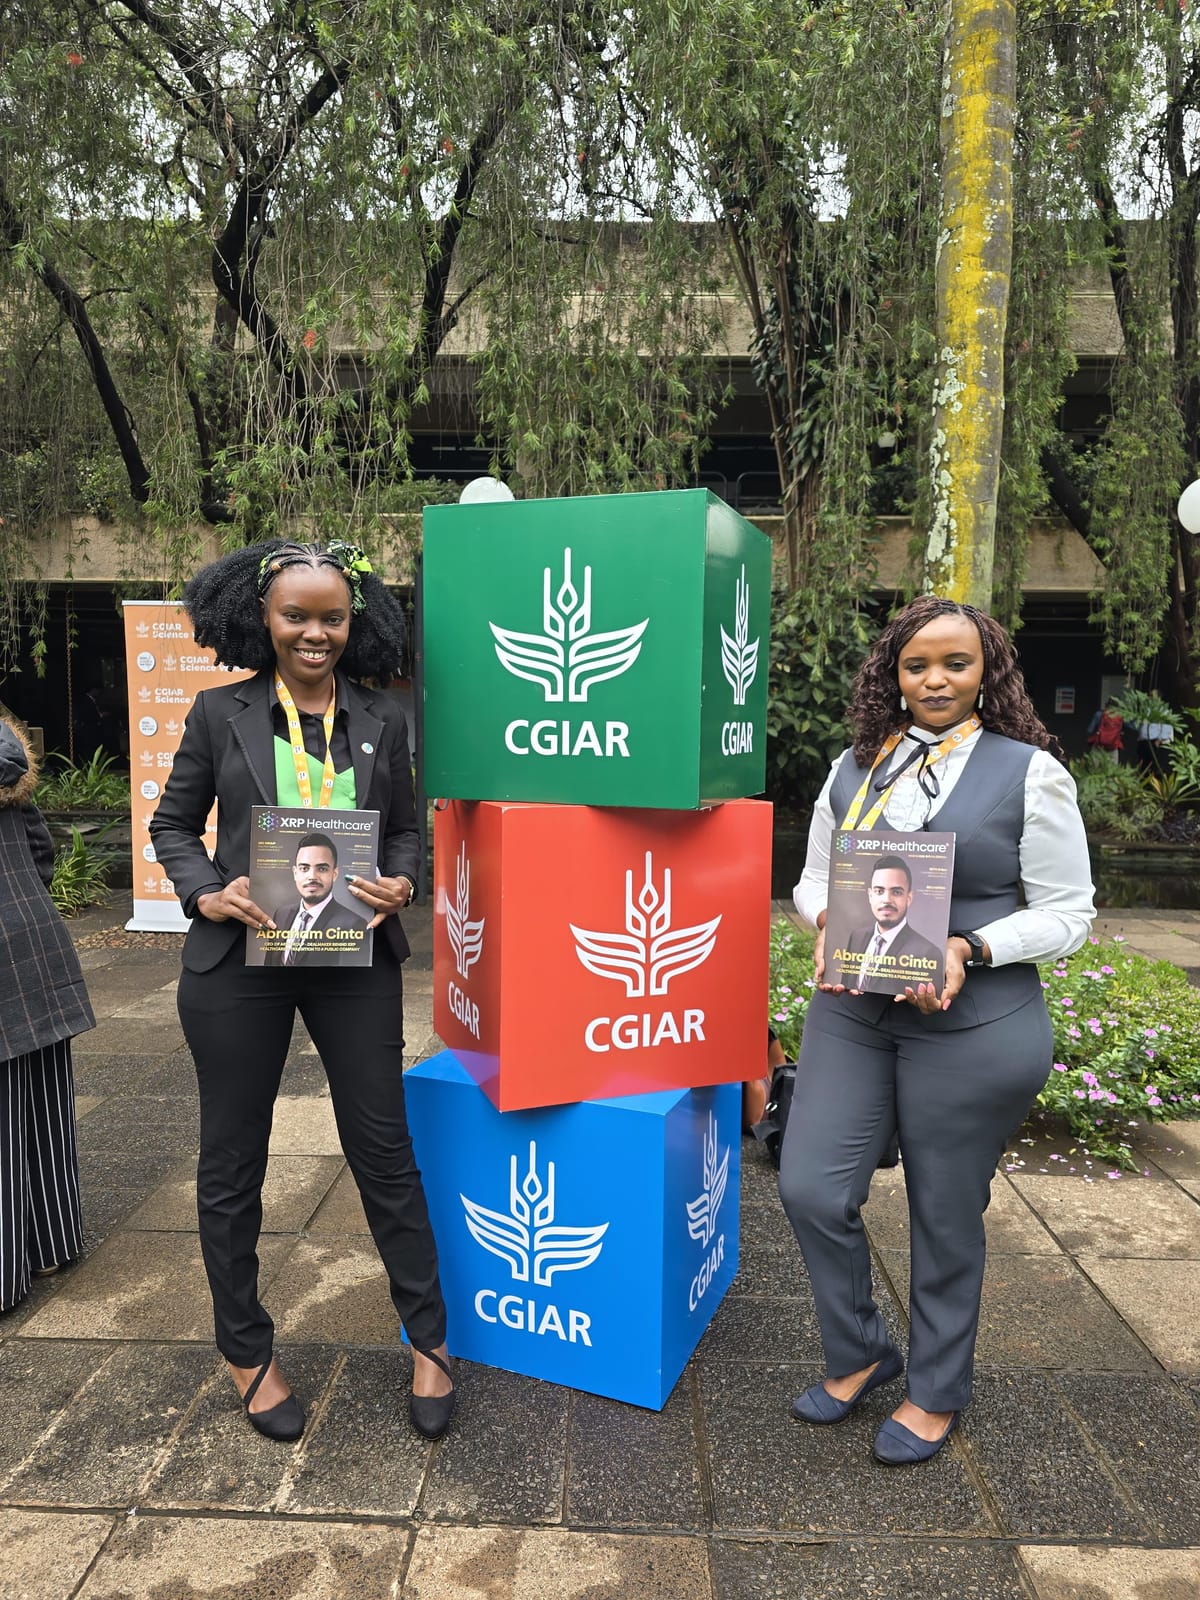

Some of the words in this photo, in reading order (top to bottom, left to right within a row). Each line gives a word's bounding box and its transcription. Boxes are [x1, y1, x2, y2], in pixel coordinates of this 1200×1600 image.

[152, 623, 182, 631] CGIAR
[152, 630, 189, 639] Science
[180, 656, 209, 664] CGIAR
[180, 663, 217, 672] Science
[154, 688, 184, 696] CGIAR
[155, 695, 191, 704] Science
[505, 720, 630, 757] CGIAR
[721, 722, 753, 756] CGIAR
[280, 817, 305, 828] XRP
[306, 818, 372, 831] Healthcare
[856, 839, 880, 850] XRP
[881, 840, 947, 853] Healthcare
[255, 928, 323, 940] Abraham
[326, 927, 364, 940] Cinta
[833, 948, 897, 966] Abraham
[899, 954, 938, 970] Cinta
[448, 981, 481, 1040] CGIAR
[585, 1009, 706, 1052] CGIAR
[689, 1234, 725, 1312] CGIAR
[474, 1289, 593, 1347] CGIAR
